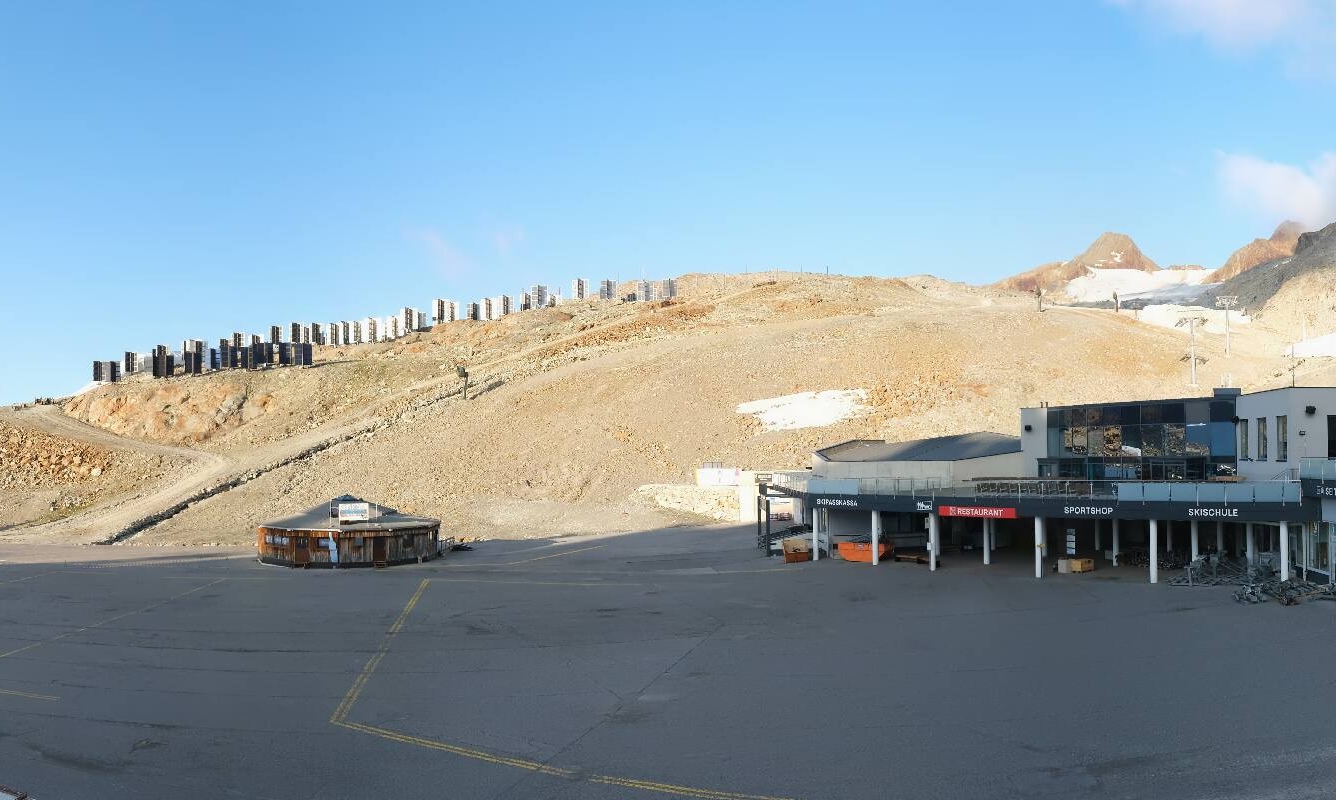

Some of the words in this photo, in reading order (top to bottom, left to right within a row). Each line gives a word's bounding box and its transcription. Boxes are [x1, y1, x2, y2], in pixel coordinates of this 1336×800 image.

[957, 507, 1003, 517] RESTAURANT
[1064, 506, 1114, 515] SPORTSHOP
[1188, 508, 1239, 517] SKISCHULE
